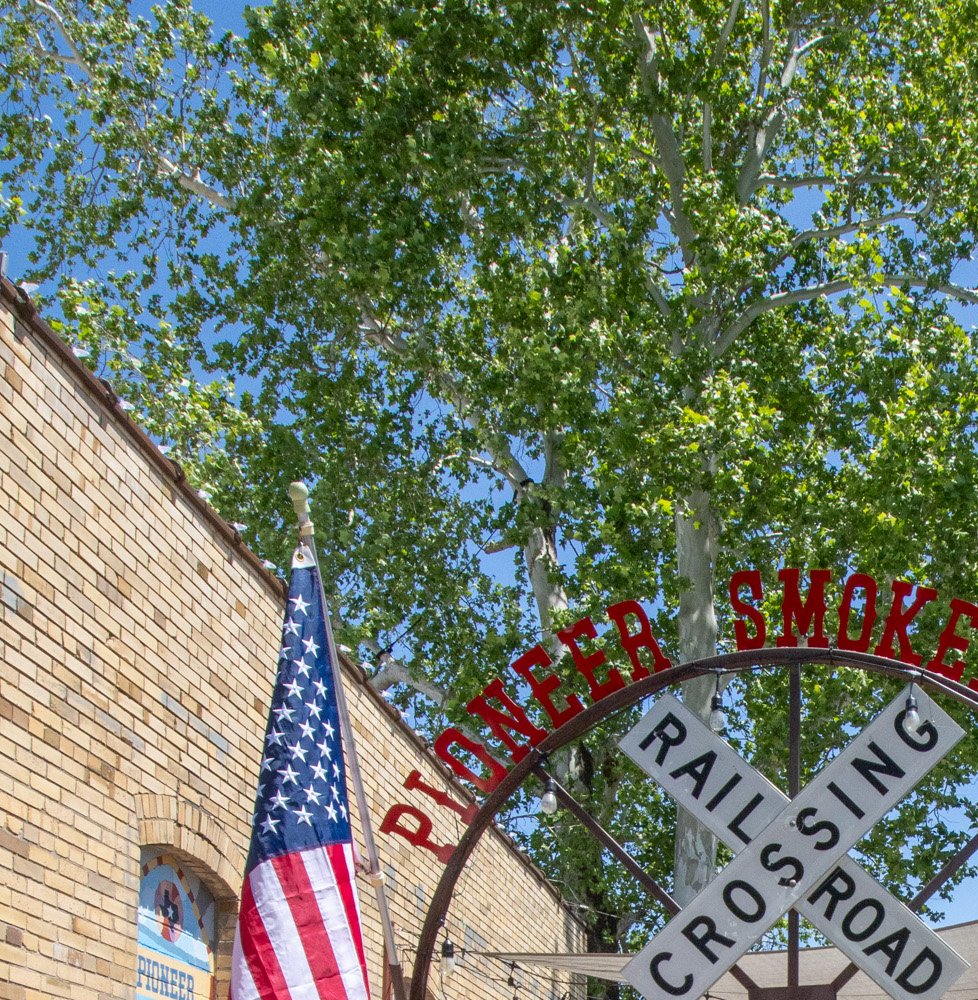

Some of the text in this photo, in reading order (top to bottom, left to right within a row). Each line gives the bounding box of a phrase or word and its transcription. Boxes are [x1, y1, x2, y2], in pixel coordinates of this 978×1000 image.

[380, 600, 671, 862] PIONEER
[638, 711, 943, 995] RAIL ROAD
[649, 705, 939, 997] CROSSING
